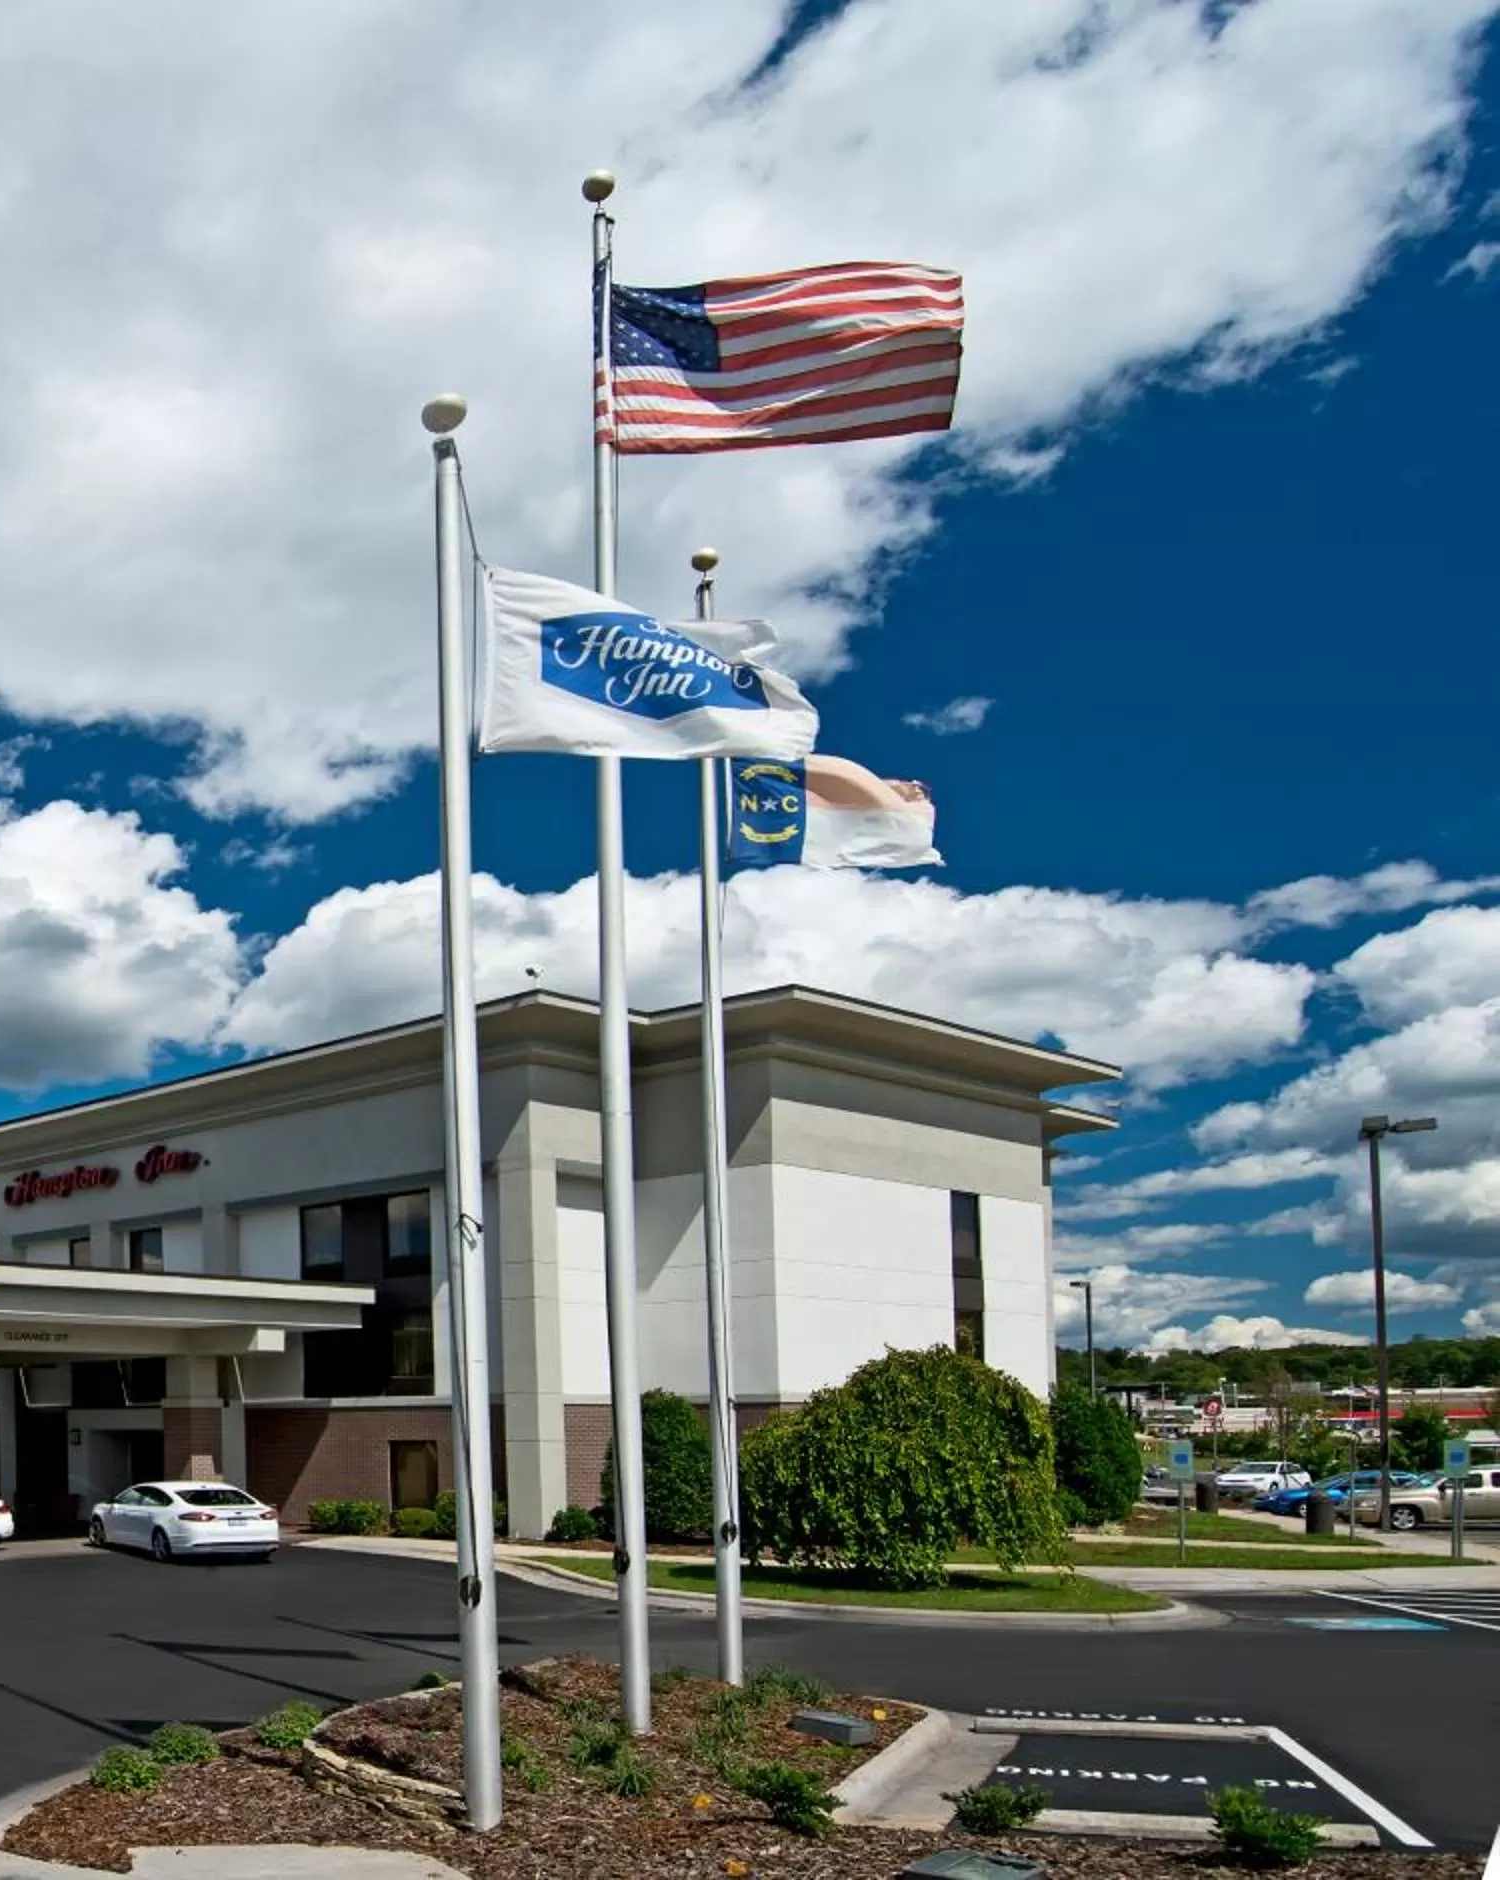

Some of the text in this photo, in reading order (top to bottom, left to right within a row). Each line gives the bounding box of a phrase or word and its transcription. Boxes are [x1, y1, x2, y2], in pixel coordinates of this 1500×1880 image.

[554, 625, 733, 676] Hampton
[605, 661, 713, 708] Inn
[740, 794, 800, 814] N C
[4, 1145, 203, 1207] Hampton Inn
[995, 1764, 1209, 1786] PARKING
